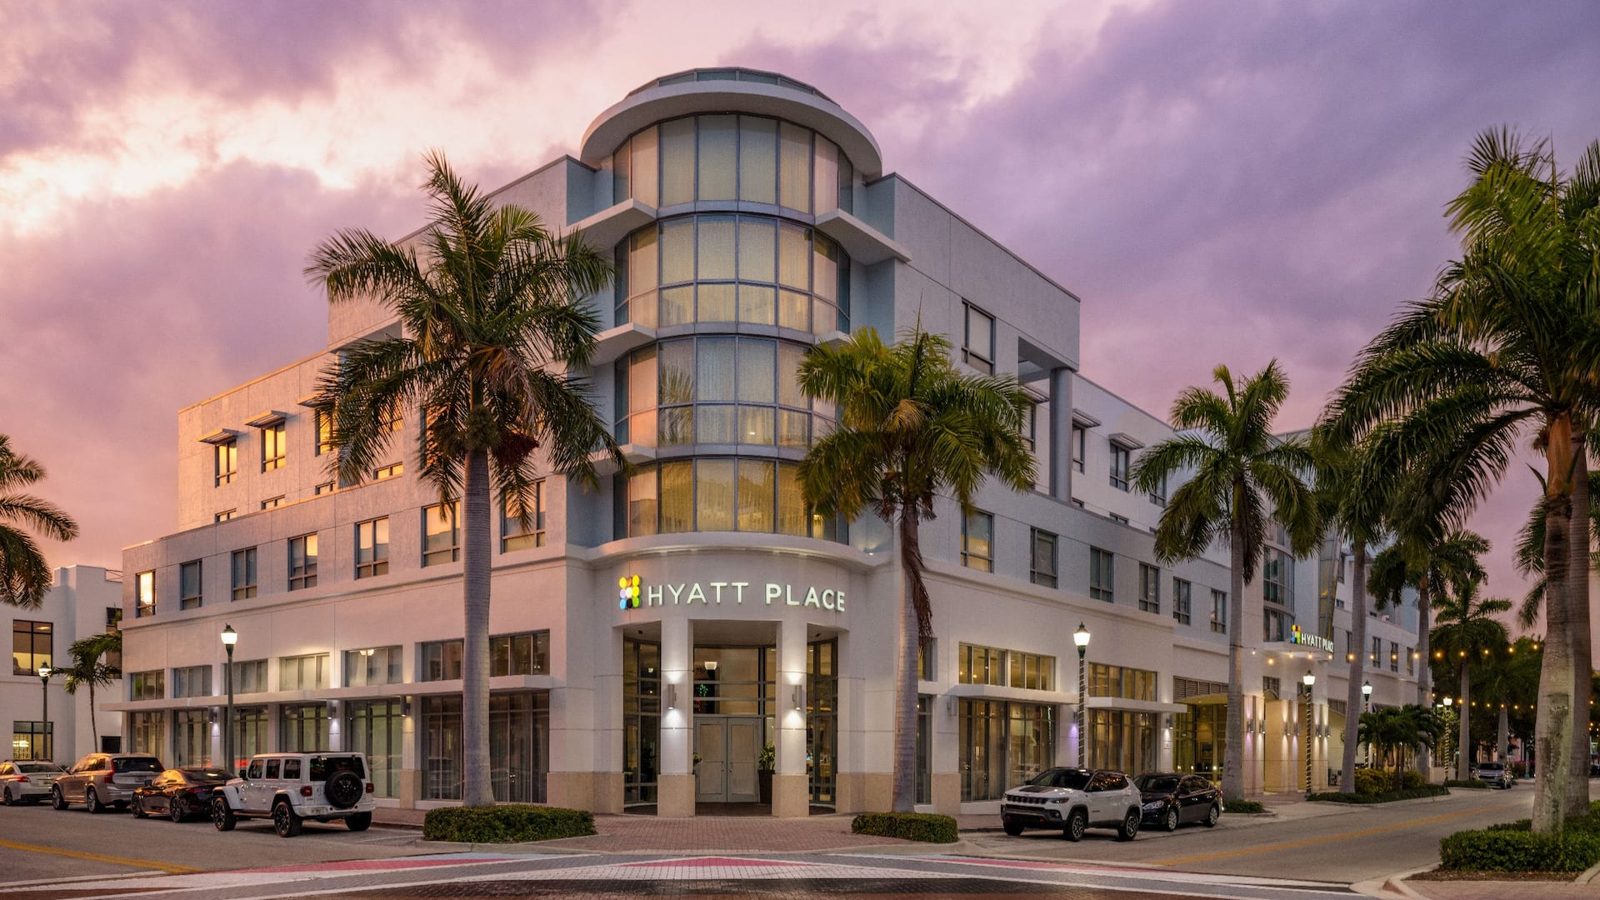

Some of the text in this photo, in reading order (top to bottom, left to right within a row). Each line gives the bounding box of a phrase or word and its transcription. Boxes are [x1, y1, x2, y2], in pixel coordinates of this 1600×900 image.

[648, 582, 846, 612] HYATT PLACE
[1301, 633, 1334, 653] HYATT PLAC
